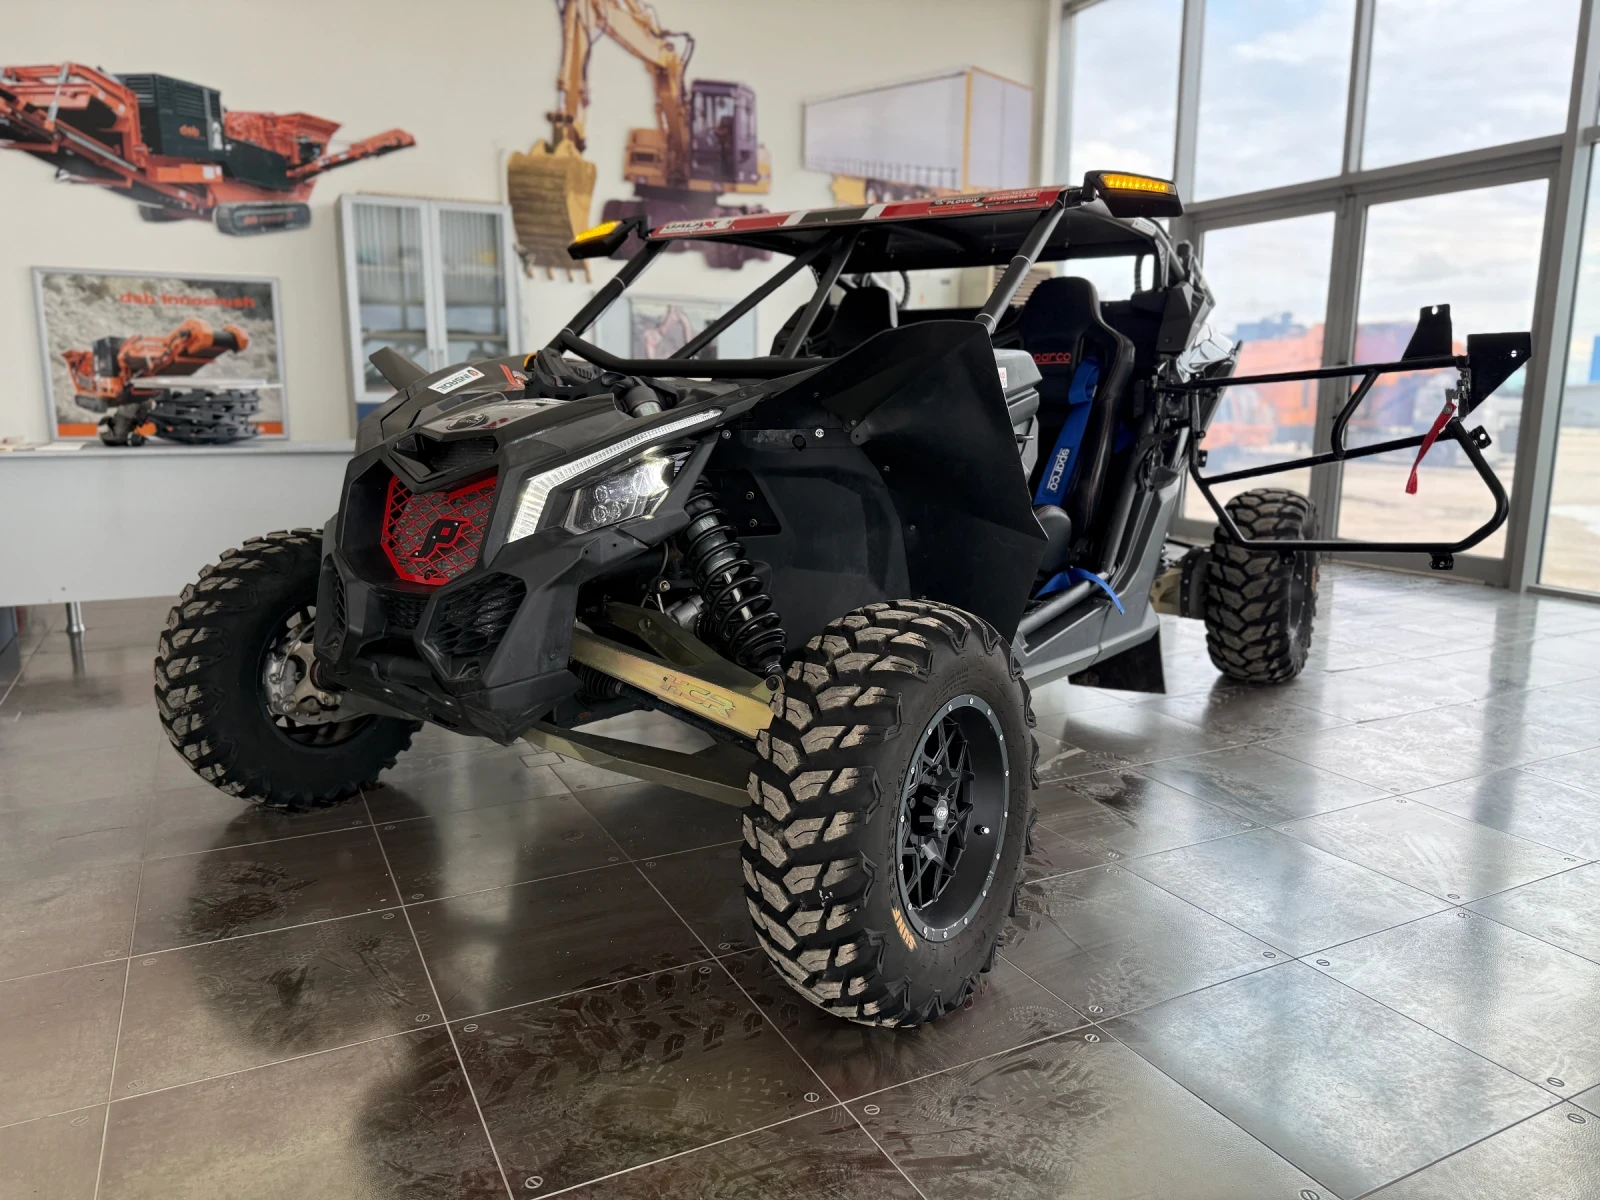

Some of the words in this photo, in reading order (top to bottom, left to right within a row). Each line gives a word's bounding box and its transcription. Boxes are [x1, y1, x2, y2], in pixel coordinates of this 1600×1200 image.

[946, 197, 980, 205] PLOVDIV
[1033, 352, 1072, 365] parco
[660, 674, 736, 718] HCR
